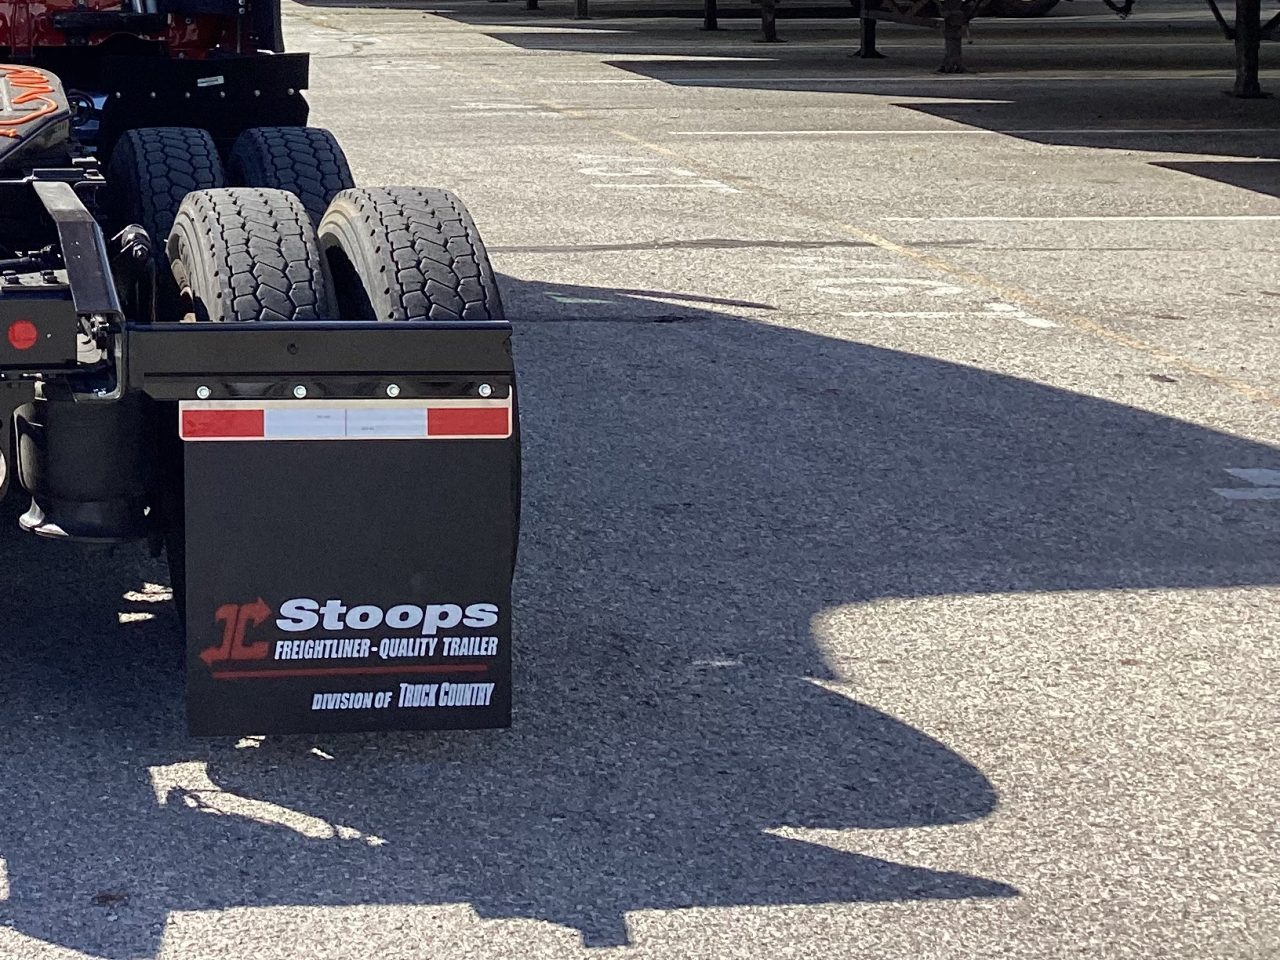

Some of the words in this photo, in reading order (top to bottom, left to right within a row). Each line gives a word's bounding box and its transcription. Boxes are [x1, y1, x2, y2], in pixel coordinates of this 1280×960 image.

[275, 597, 499, 635] Stoops
[442, 636, 499, 657] TRAILER
[311, 692, 373, 710] DIVISION
[374, 691, 393, 708] OF
[397, 682, 438, 708] TRUCK
[438, 681, 496, 707] COUNTRY
